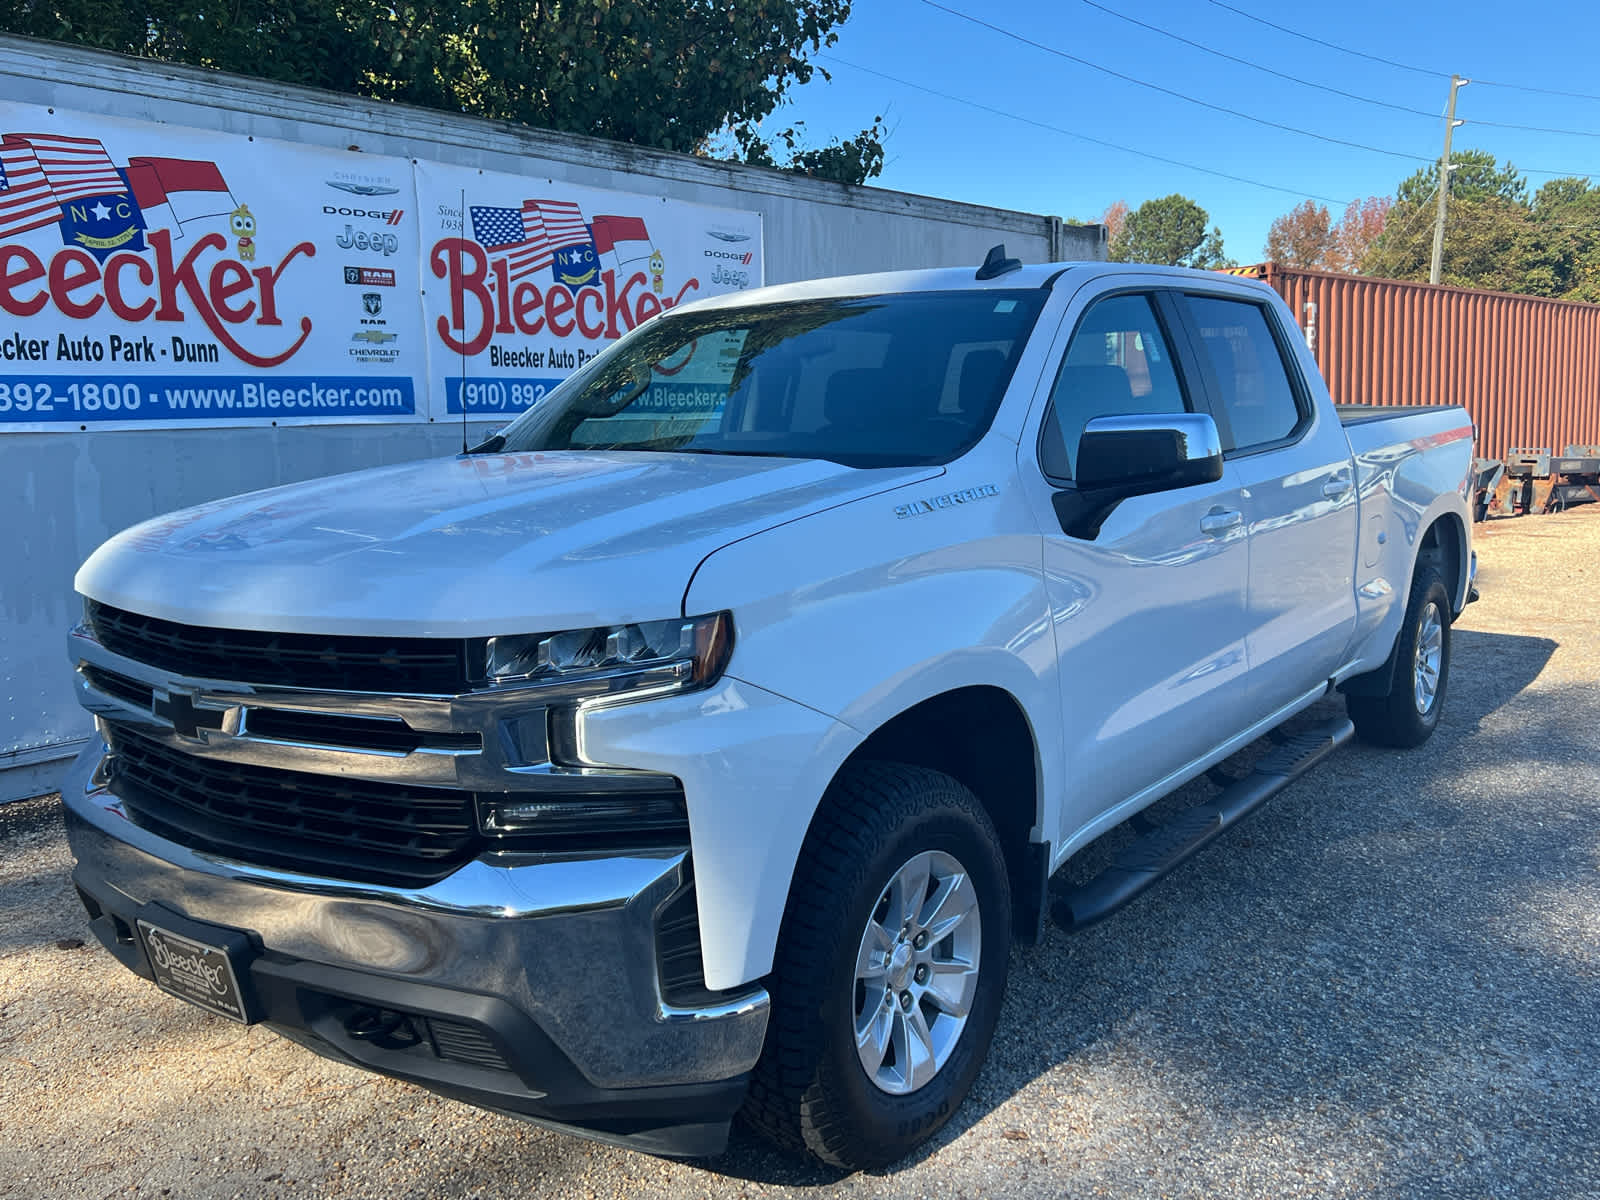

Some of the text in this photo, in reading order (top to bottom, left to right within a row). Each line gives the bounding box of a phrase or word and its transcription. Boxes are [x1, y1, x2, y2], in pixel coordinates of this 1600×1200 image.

[70, 202, 132, 223] N C
[323, 206, 393, 220] DODGE
[335, 224, 399, 257] Jeep
[558, 250, 594, 265] N C
[704, 250, 746, 261] DODGE
[363, 271, 393, 279] RAM
[711, 264, 749, 289] Jeep
[0, 331, 219, 363] cker Auto Park Dunn
[348, 348, 400, 356] CHEVROLET
[490, 345, 545, 368] Bleecker
[548, 347, 575, 369] Auto
[165, 382, 402, 409] www.Bleecker.com
[458, 381, 507, 409] (910)
[894, 484, 1001, 520] SILVERADO
[149, 934, 228, 996] Bleecker
